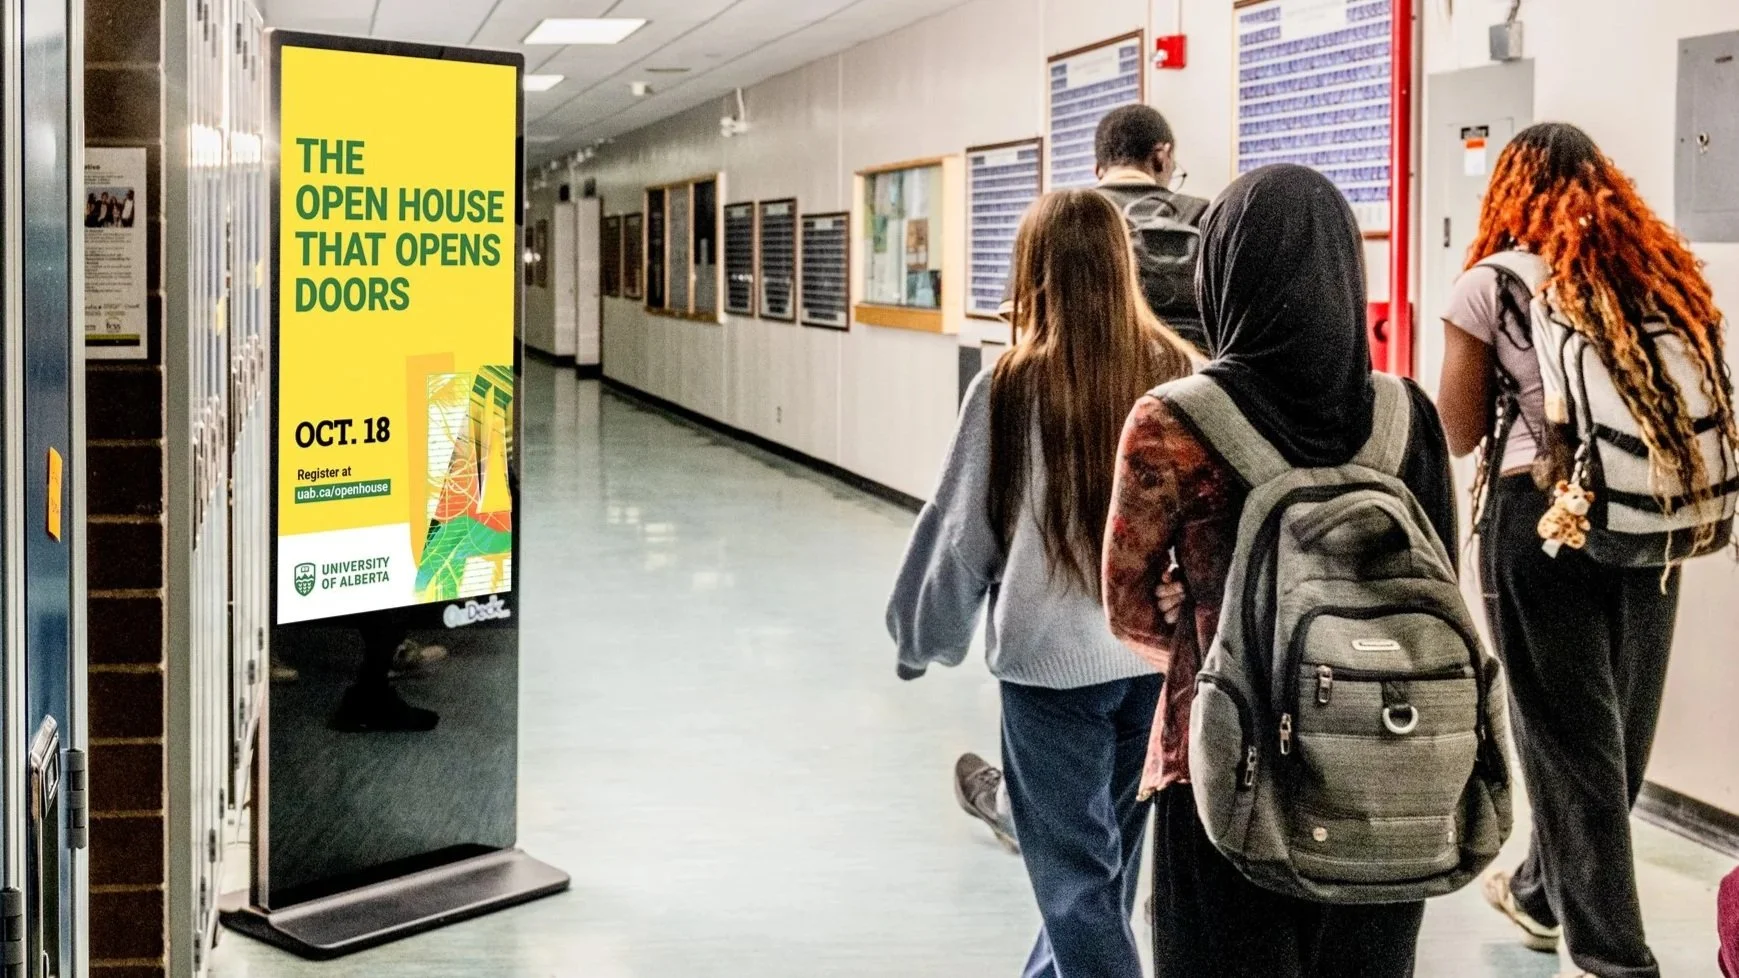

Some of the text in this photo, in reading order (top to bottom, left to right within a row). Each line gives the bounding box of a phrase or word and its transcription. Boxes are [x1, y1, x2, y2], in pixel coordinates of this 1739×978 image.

[296, 138, 364, 175] THE
[295, 185, 505, 224] OPEN HOUSE
[295, 232, 501, 267] THAT OPENS
[295, 277, 410, 313] DOORS
[295, 417, 391, 449] OCT. 18
[297, 466, 352, 483] Register at
[297, 482, 389, 500] uab.ca/openhouse
[321, 556, 390, 576] UNIVERSITY
[321, 570, 390, 590] OF ALBERTA
